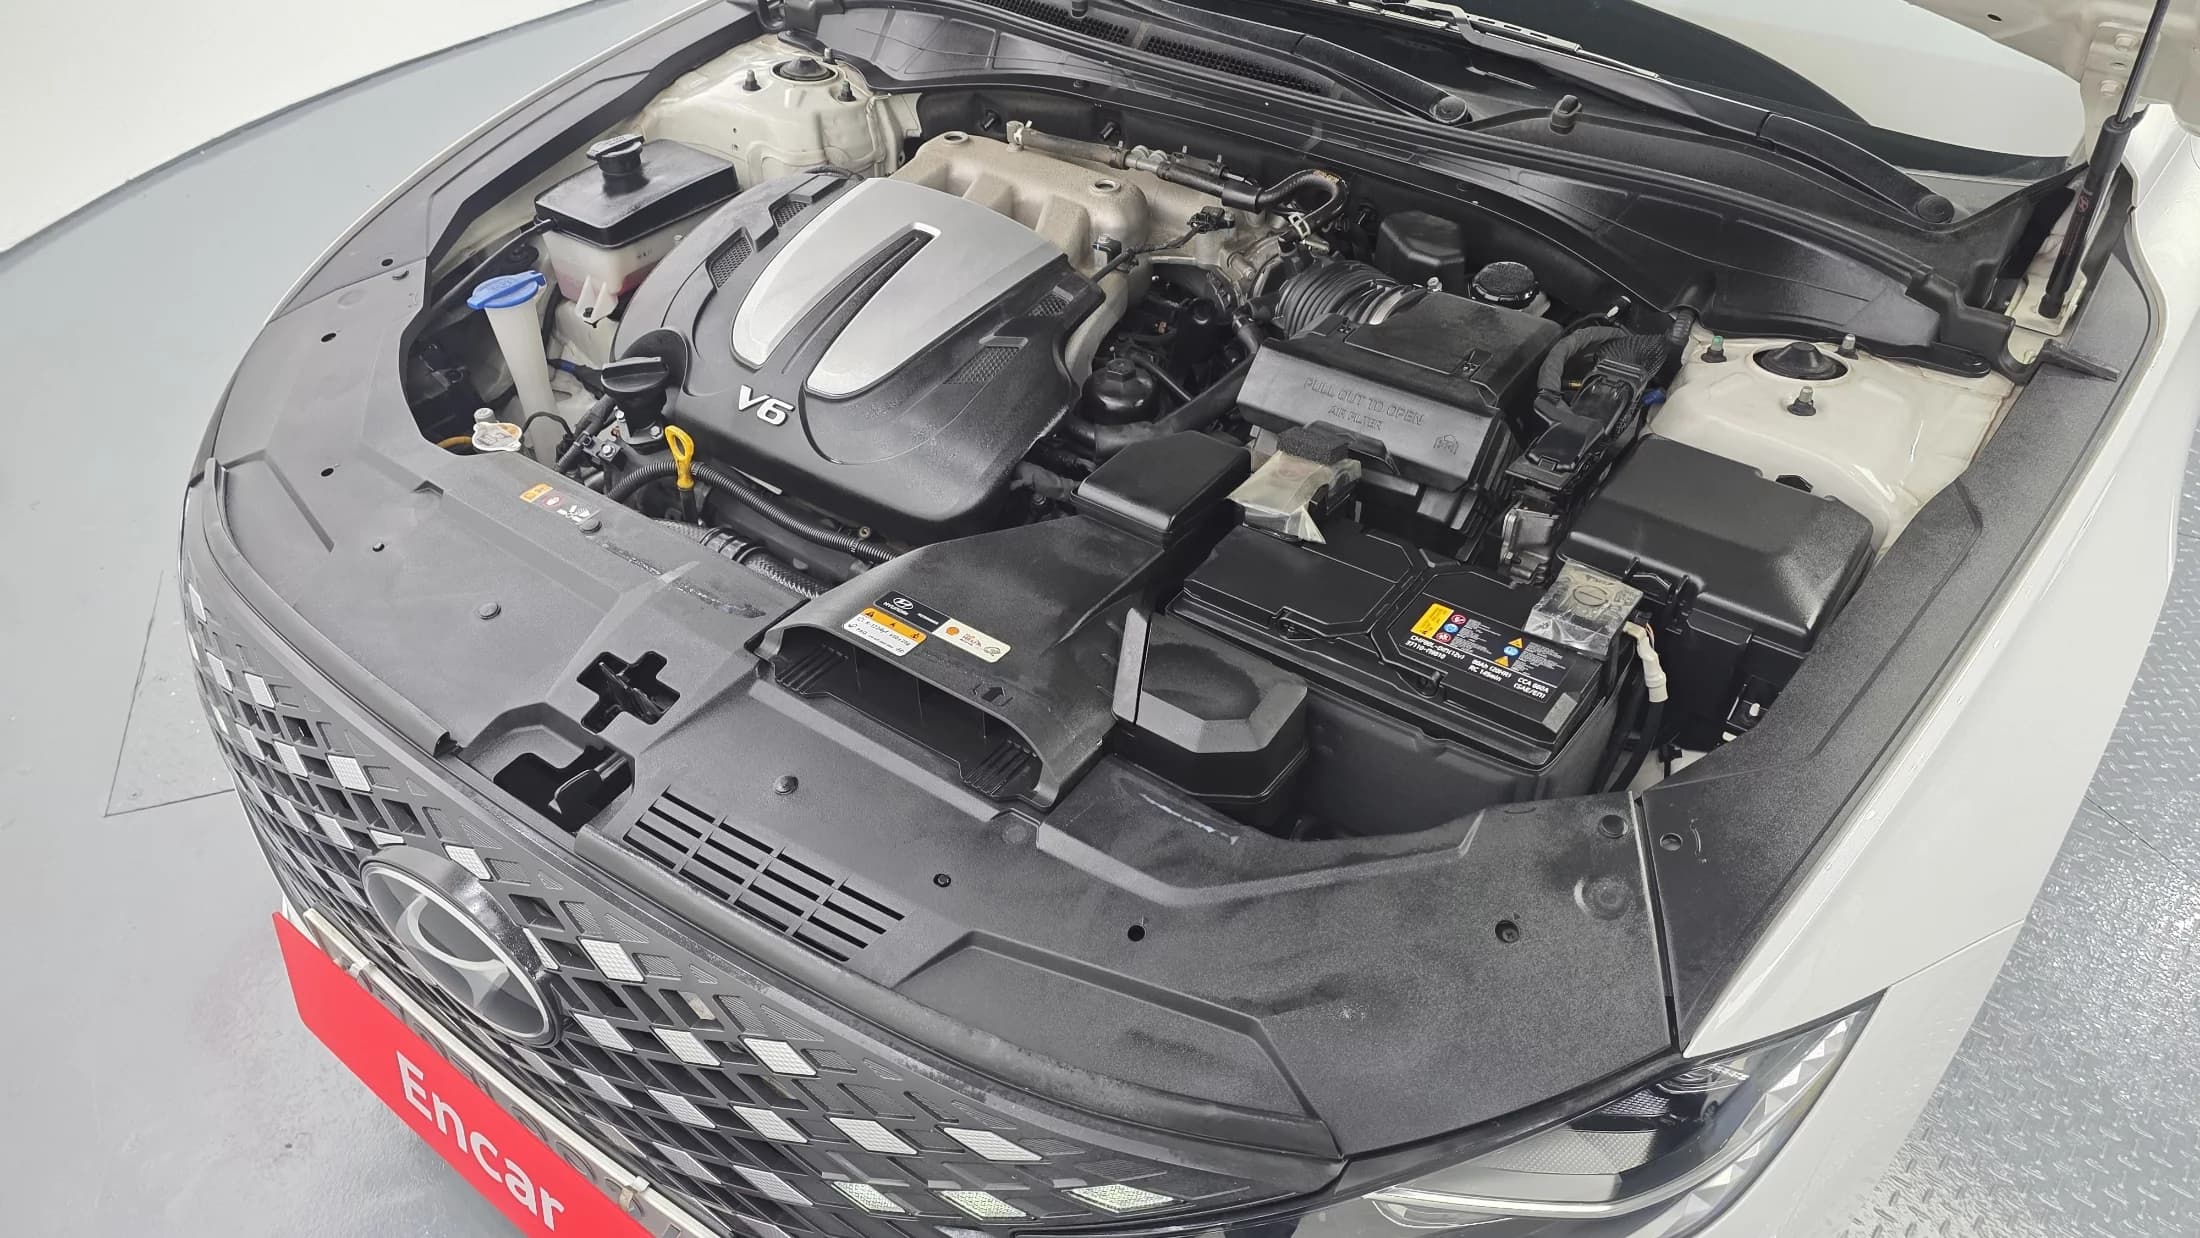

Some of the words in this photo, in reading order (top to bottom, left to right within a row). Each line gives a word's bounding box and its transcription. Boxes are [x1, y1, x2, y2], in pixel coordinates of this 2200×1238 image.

[738, 384, 795, 426] V6
[1303, 376, 1335, 398] PULL
[1337, 390, 1366, 406] OUT
[1367, 398, 1383, 412] TO
[1386, 403, 1424, 426] OPEN
[1327, 405, 1347, 419] AIR
[1347, 410, 1383, 430] FILTER
[1517, 677, 1532, 687] CCA
[396, 1049, 565, 1232] Encar
